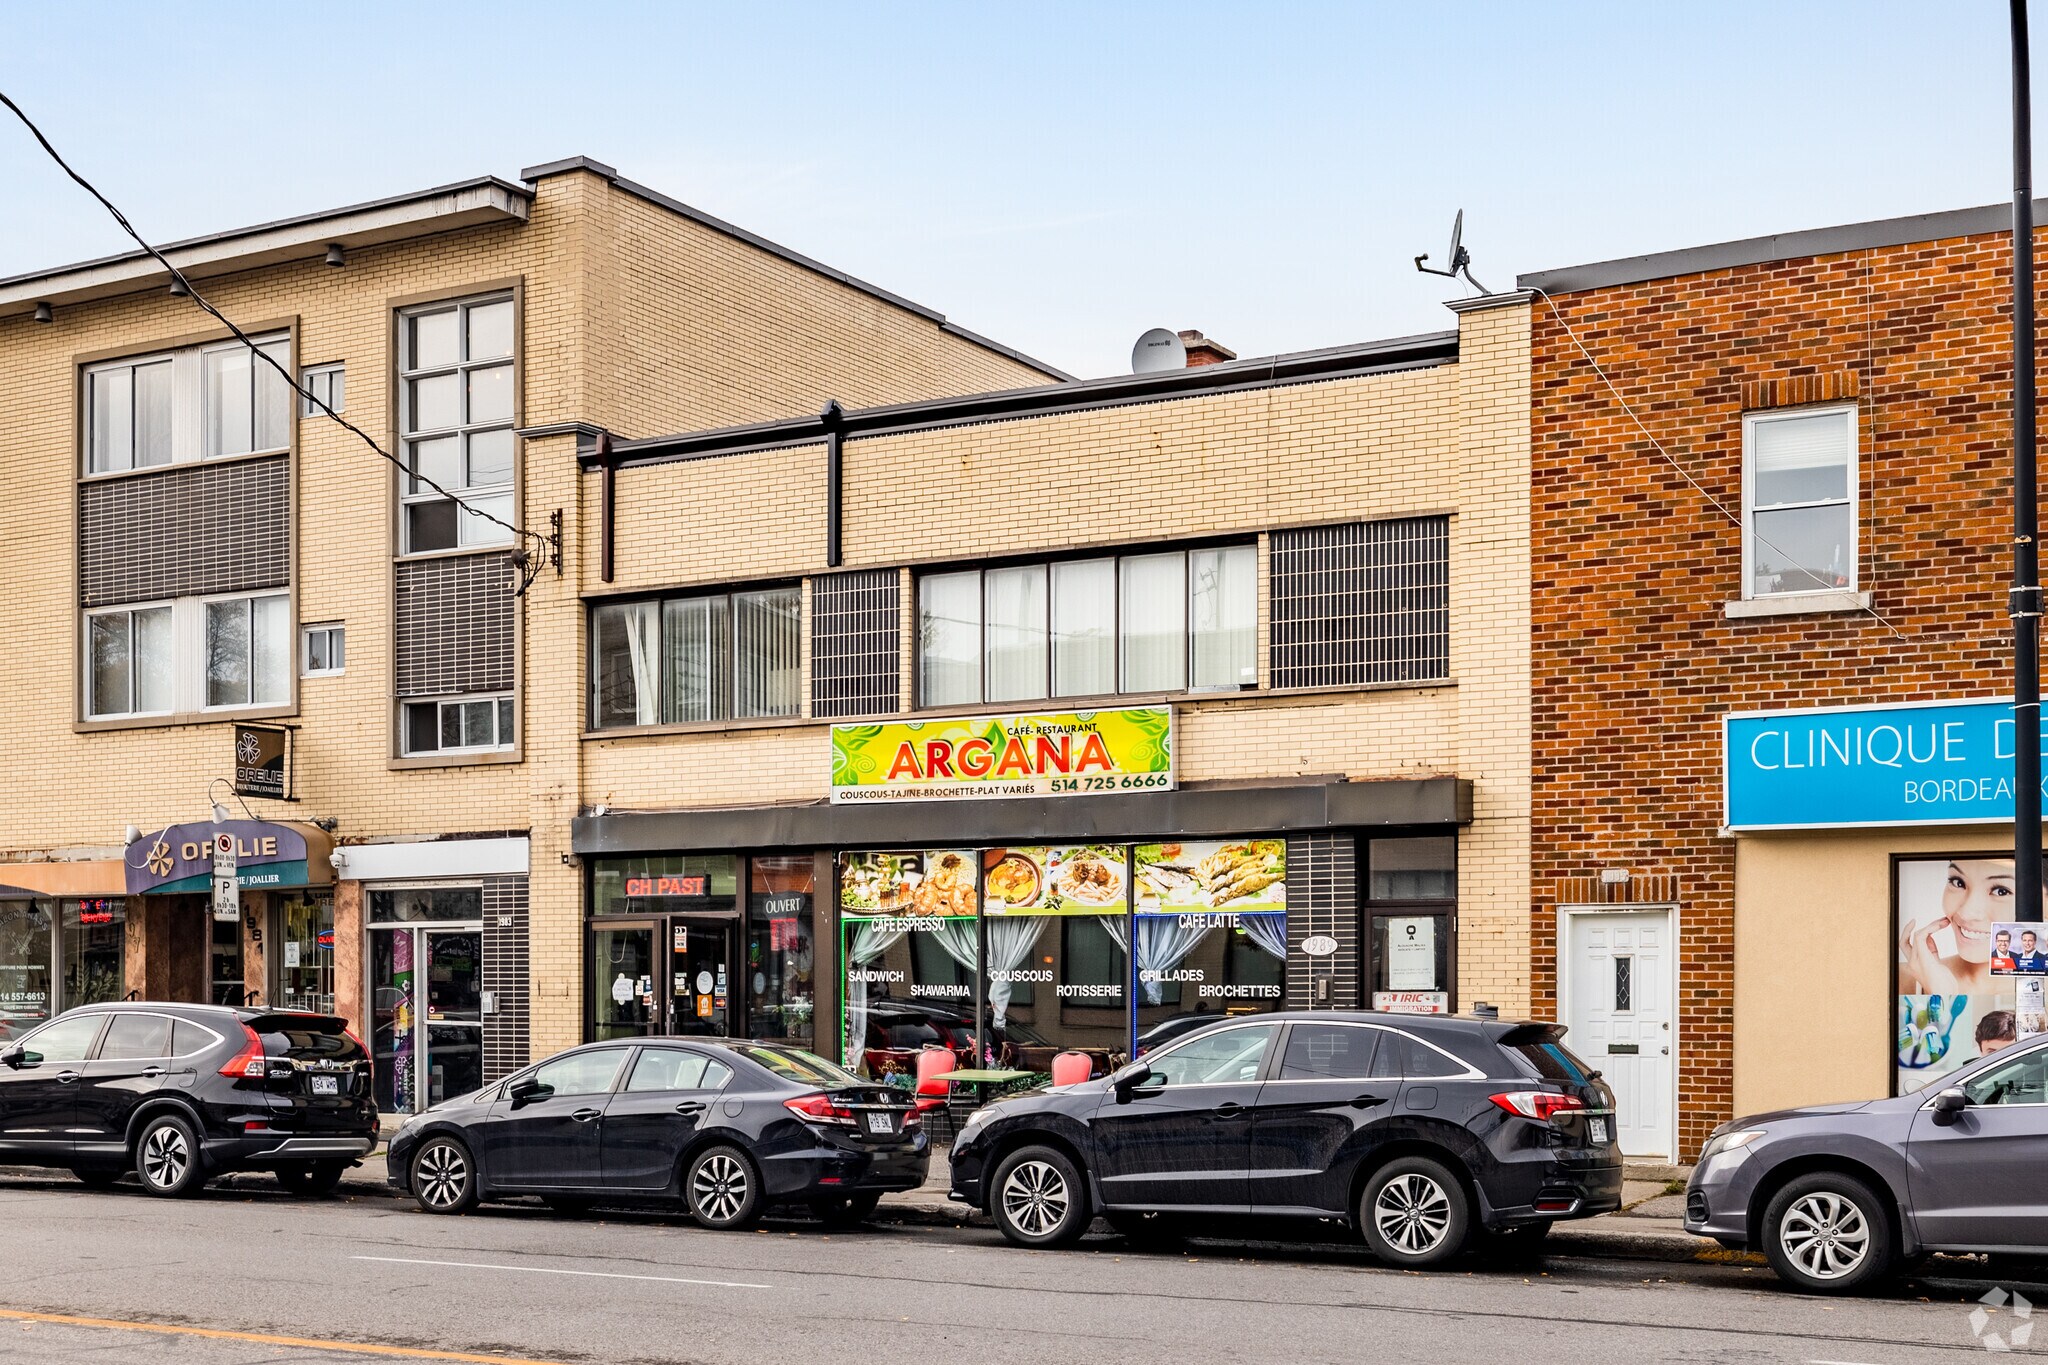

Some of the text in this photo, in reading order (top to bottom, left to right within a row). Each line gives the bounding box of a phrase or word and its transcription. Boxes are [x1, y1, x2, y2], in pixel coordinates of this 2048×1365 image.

[1036, 722, 1098, 736] RESTAURANT
[1751, 721, 1966, 769] CLINIQUE
[887, 731, 1115, 780] ARGANA
[236, 766, 284, 785] ORELIE
[1050, 773, 1168, 793] 514 725 6666
[839, 783, 1036, 800] COUSCOUS-TAJINE-BROCHETTE-PLAT VARIÉS
[223, 881, 230, 894] P
[626, 877, 705, 896] CH PAST
[765, 897, 801, 914] OUVERT
[0, 911, 19, 925] ALON
[896, 916, 946, 932] ESPRESSO
[1207, 912, 1240, 928] LATTE
[1306, 938, 1333, 951] 1989
[848, 970, 904, 982] SANDWICH
[990, 970, 1053, 982] COUSCOUS
[1139, 969, 1205, 982] GRILLADES
[1, 992, 46, 1001] 14 557-6613
[910, 985, 971, 997] SHAWARMA
[1056, 985, 1122, 997] ROTISSERIE
[1199, 985, 1281, 997] BROCHETTES
[1400, 993, 1424, 1003] IRIC
